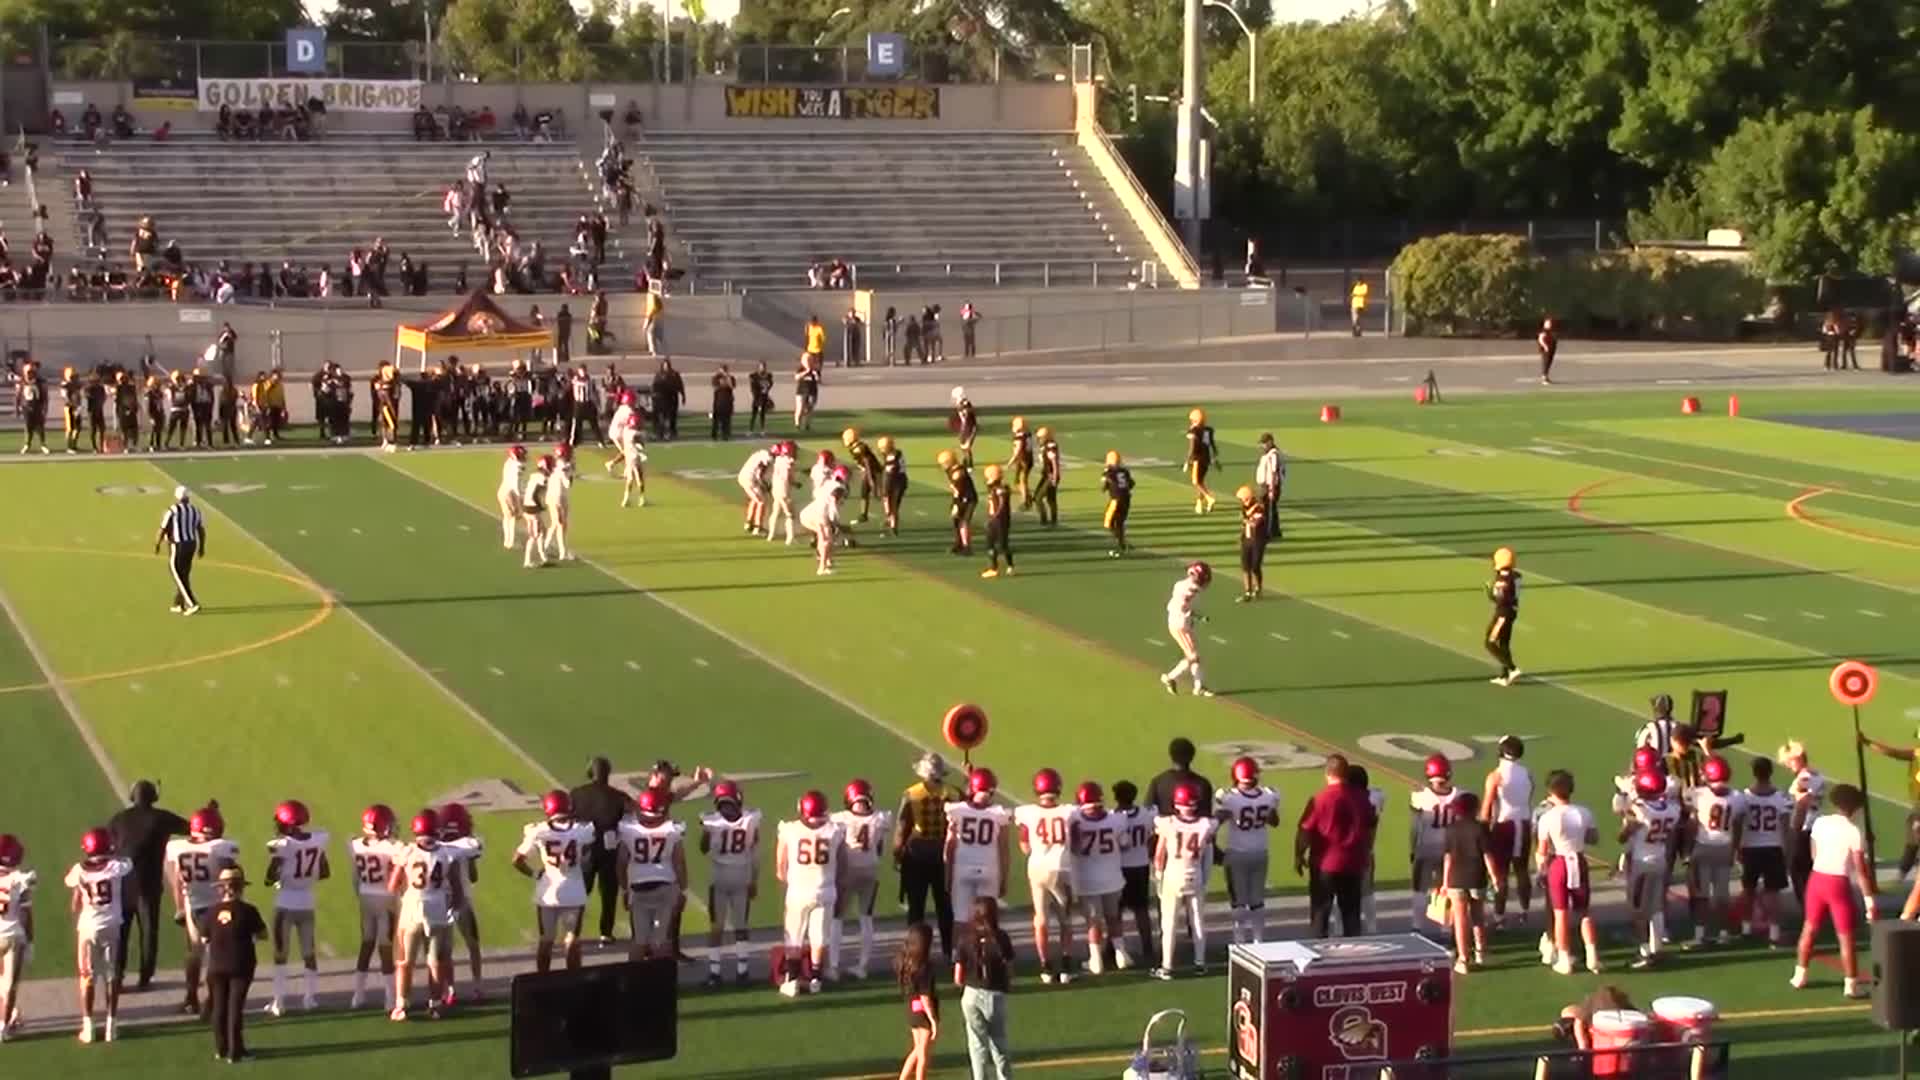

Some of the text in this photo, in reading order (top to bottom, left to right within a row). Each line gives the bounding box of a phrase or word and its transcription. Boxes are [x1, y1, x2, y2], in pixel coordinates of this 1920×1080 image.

[297, 40, 315, 62] D
[877, 43, 894, 65] E
[206, 82, 420, 108] GOLDEN BRIGADE
[728, 88, 796, 117] WISH
[828, 90, 841, 116] A
[845, 88, 937, 118] TIGER
[1701, 696, 1720, 732] 2
[1239, 806, 1268, 831] 65
[1707, 803, 1732, 831] 81
[1749, 805, 1777, 831] 32
[719, 830, 747, 855] 18
[856, 823, 870, 851] 4
[961, 817, 994, 845] 50
[1036, 817, 1066, 845] 40
[1081, 829, 1114, 855] 75
[546, 840, 577, 867] 54
[634, 838, 667, 864] 97
[797, 839, 829, 865] 66
[1175, 832, 1200, 859] 14
[178, 852, 210, 883] 55
[294, 847, 318, 879] 17
[355, 855, 384, 884] 22
[412, 861, 444, 889] 34
